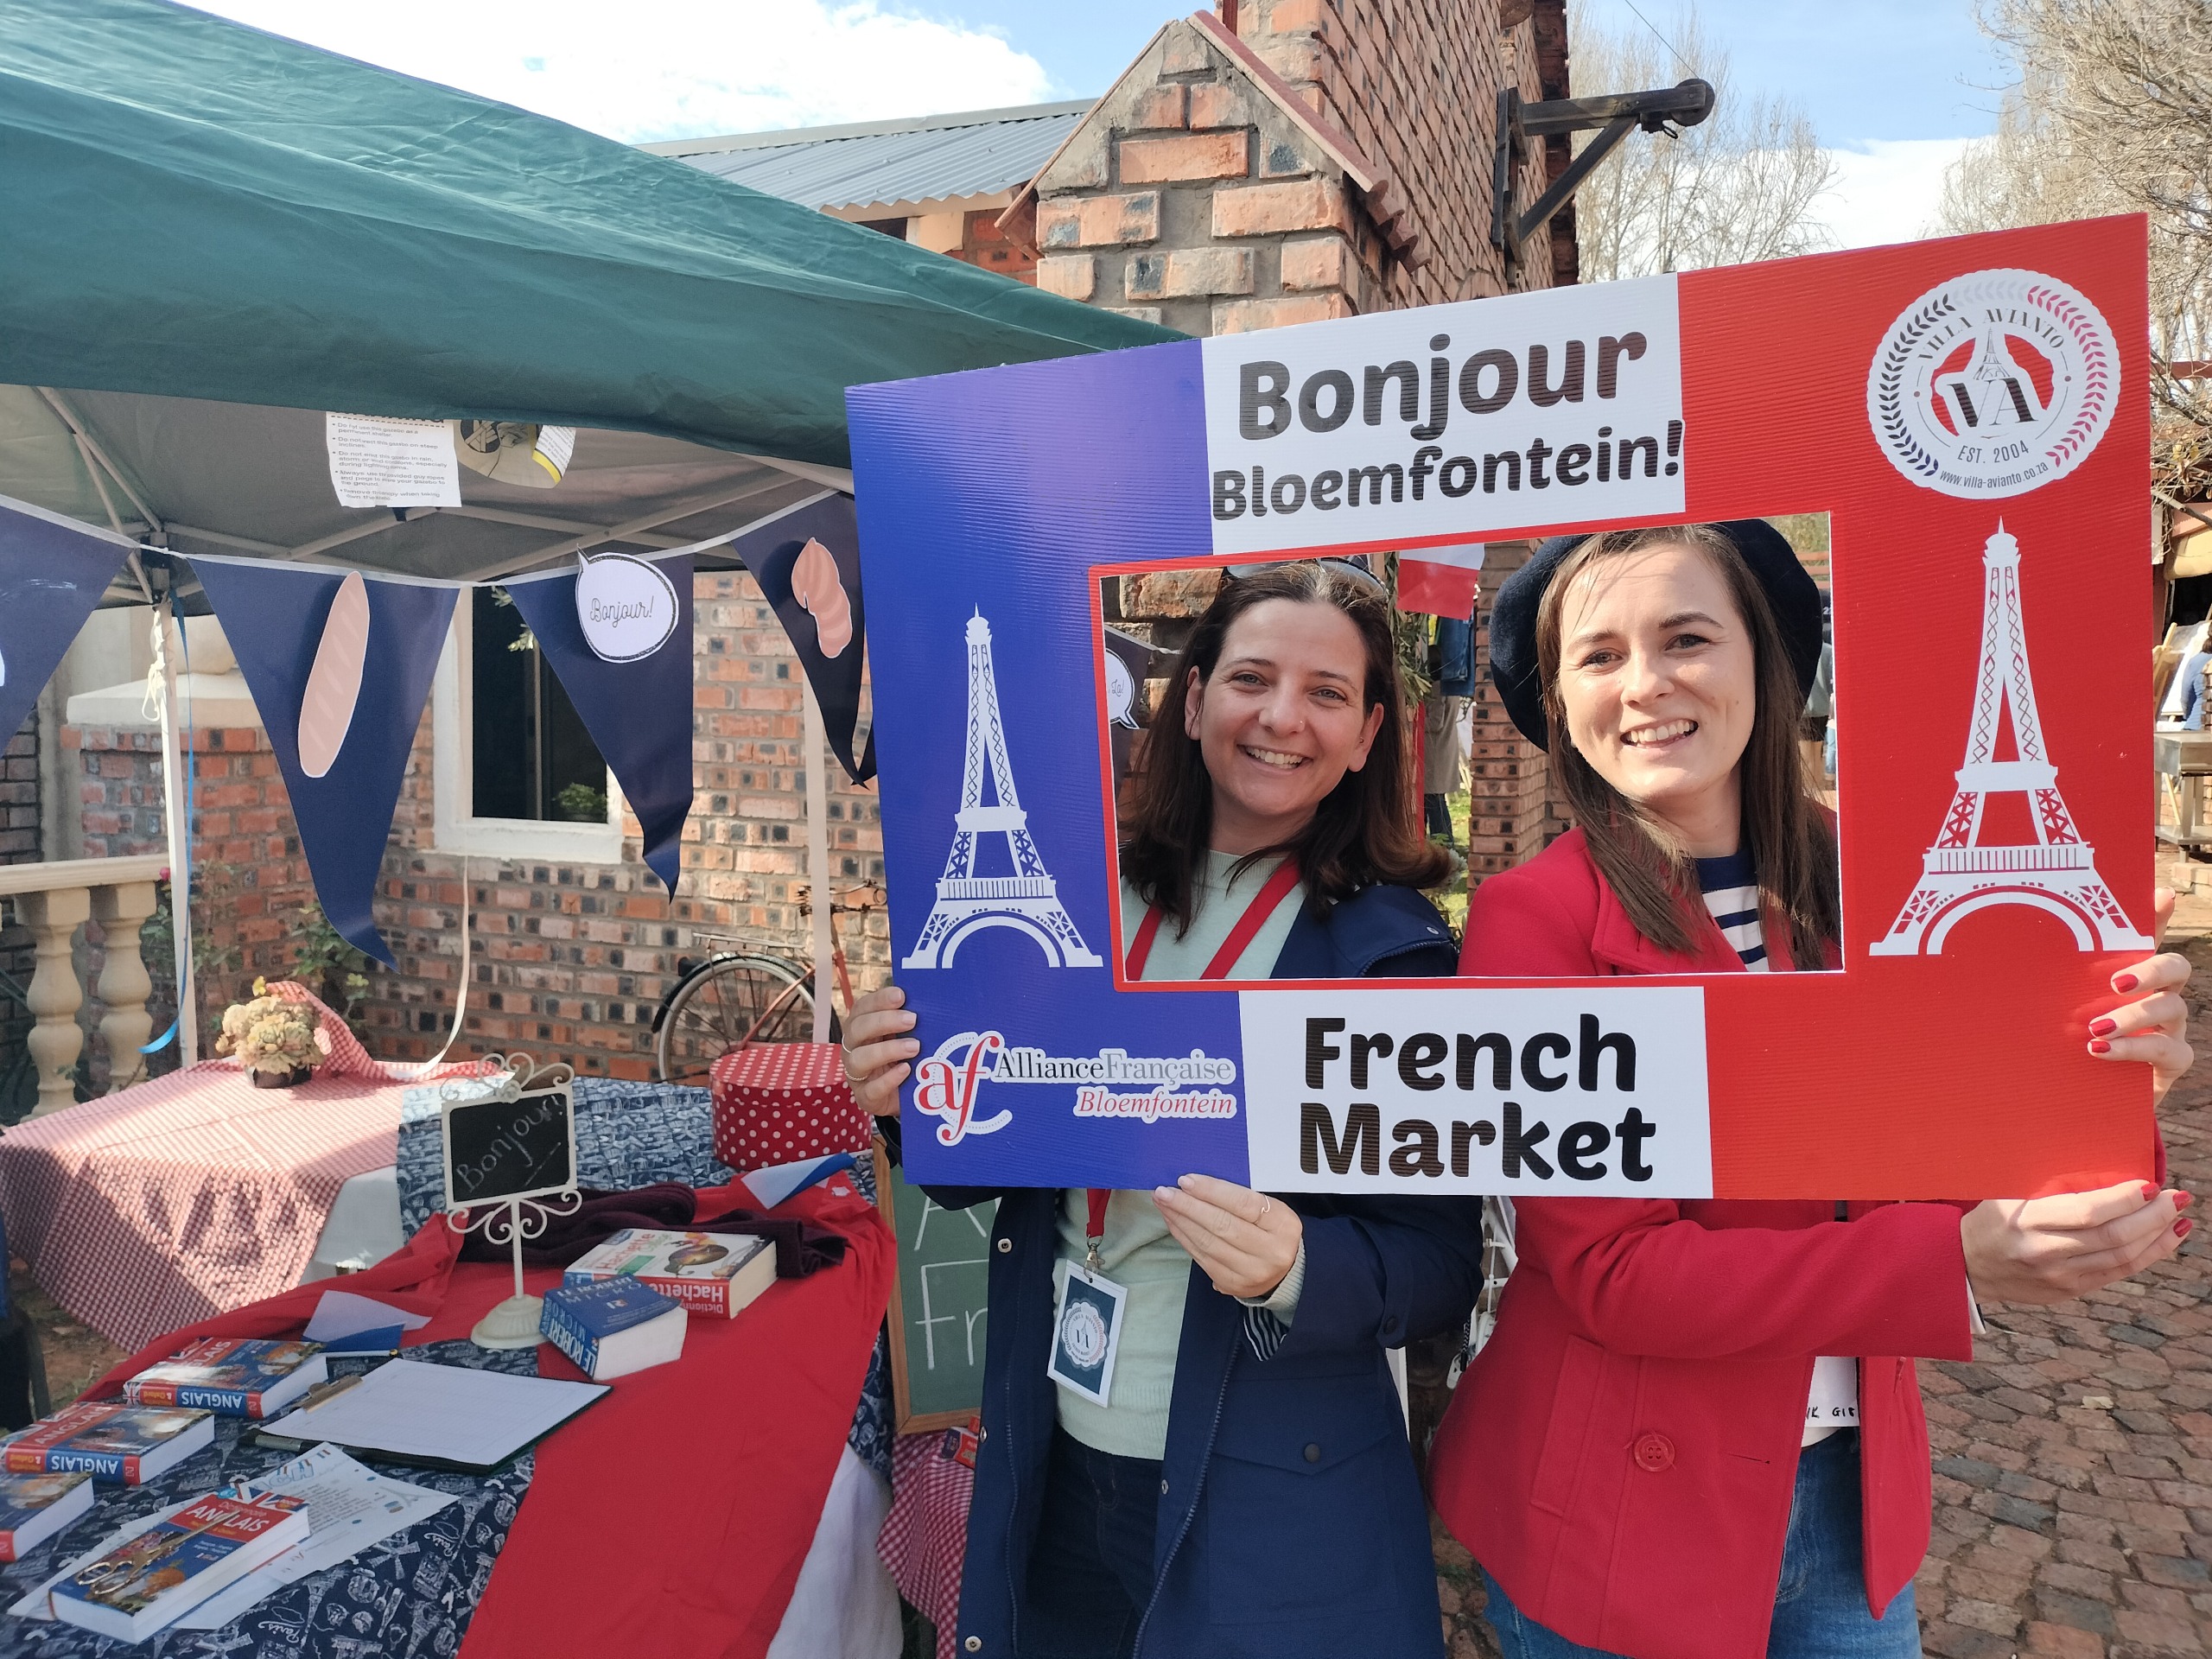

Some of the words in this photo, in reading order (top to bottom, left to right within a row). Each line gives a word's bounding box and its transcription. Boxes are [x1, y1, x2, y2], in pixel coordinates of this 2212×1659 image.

[1917, 316, 1973, 359] VILLA
[1982, 308, 2064, 348] AVIANTO
[1239, 331, 1648, 441] Bonjour
[1957, 445, 1986, 463] EST.
[1993, 440, 2029, 463] 2004
[1212, 420, 1684, 521] Bloemfontein!
[1940, 461, 2049, 489] www.villa-avianto.co.za
[589, 595, 655, 628] Bonjour!
[1305, 1014, 1637, 1092] French
[1078, 1090, 1233, 1118] Bloemfontein
[456, 1095, 563, 1193] Bonjour!
[1300, 1102, 1656, 1181] Market
[566, 1282, 642, 1304] MICRO
[576, 1276, 633, 1293] ROBERT
[649, 1282, 723, 1302] Hachette
[551, 1302, 586, 1342] MICRO
[189, 1340, 232, 1367] GLAIS
[547, 1318, 585, 1365] ROBERT
[582, 1348, 598, 1377] LE
[181, 1390, 243, 1409] ANGLAIS
[51, 1455, 118, 1475] ANGLAIS
